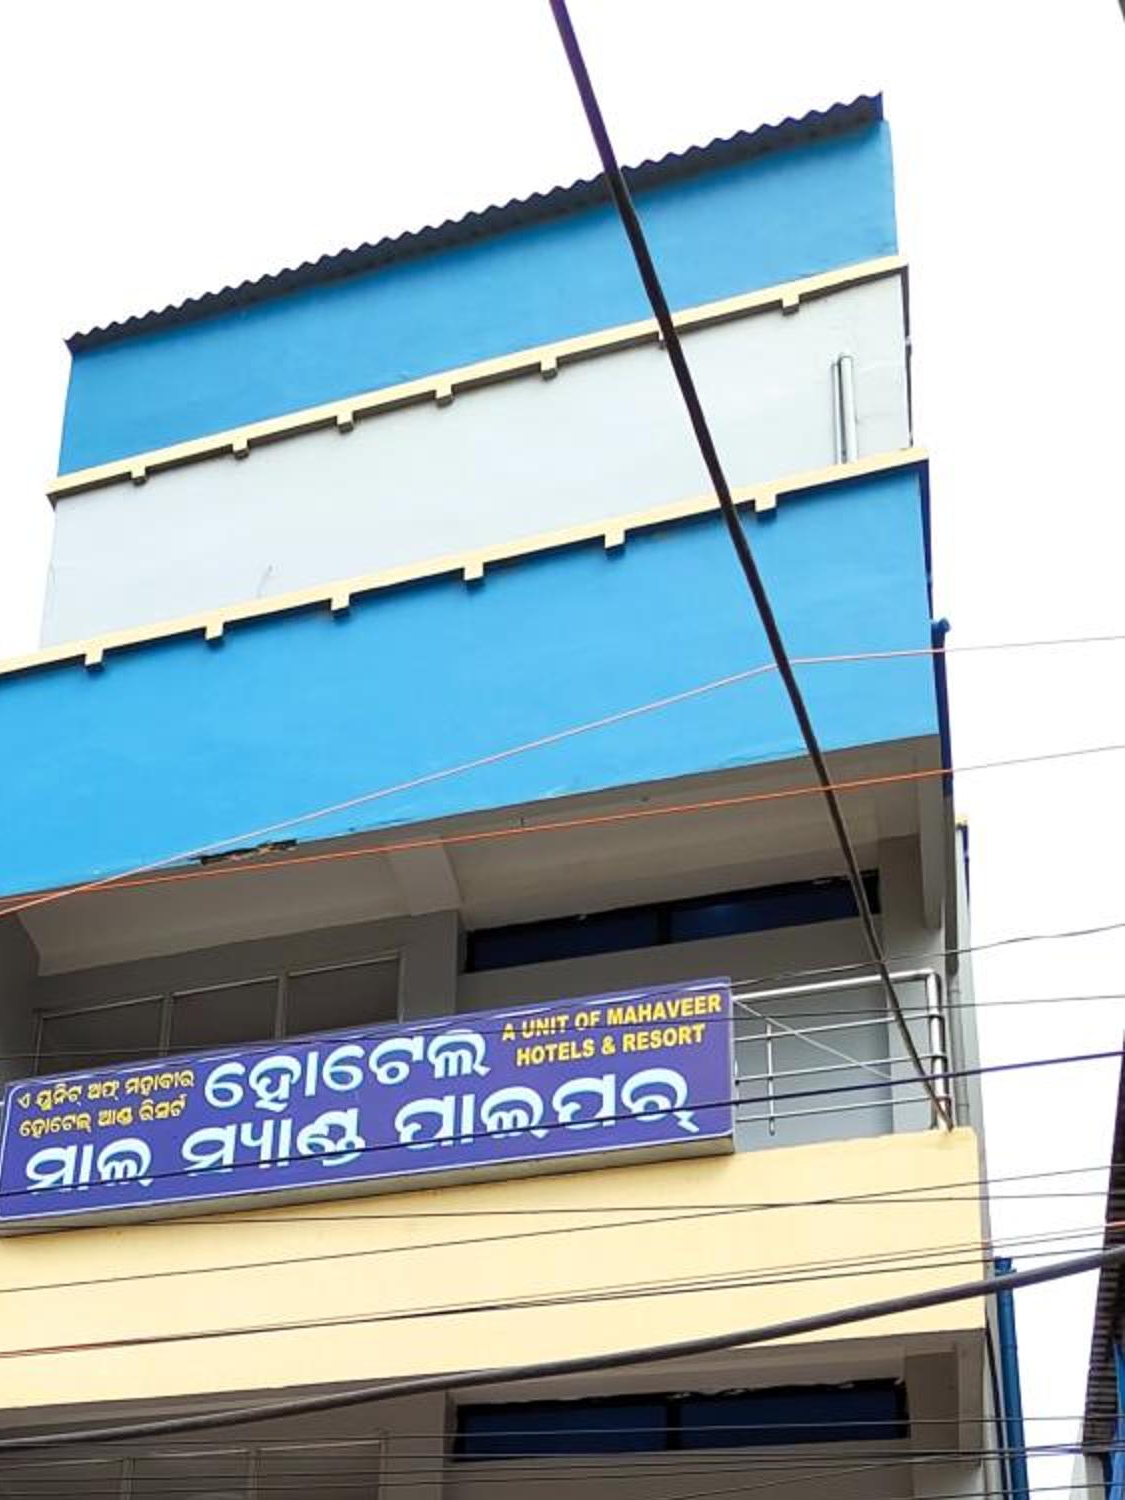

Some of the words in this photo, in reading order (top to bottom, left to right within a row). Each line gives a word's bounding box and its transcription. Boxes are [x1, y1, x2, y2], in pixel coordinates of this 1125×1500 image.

[502, 1023, 516, 1041] A
[522, 1014, 569, 1038] UNIT
[575, 1011, 601, 1030] OF
[606, 993, 722, 1026] MAHAVEER
[516, 1038, 595, 1066] HOTELS
[601, 1036, 616, 1056] &
[622, 1023, 706, 1053] RESORT
[204, 1029, 491, 1113] ହୋଟେଲ
